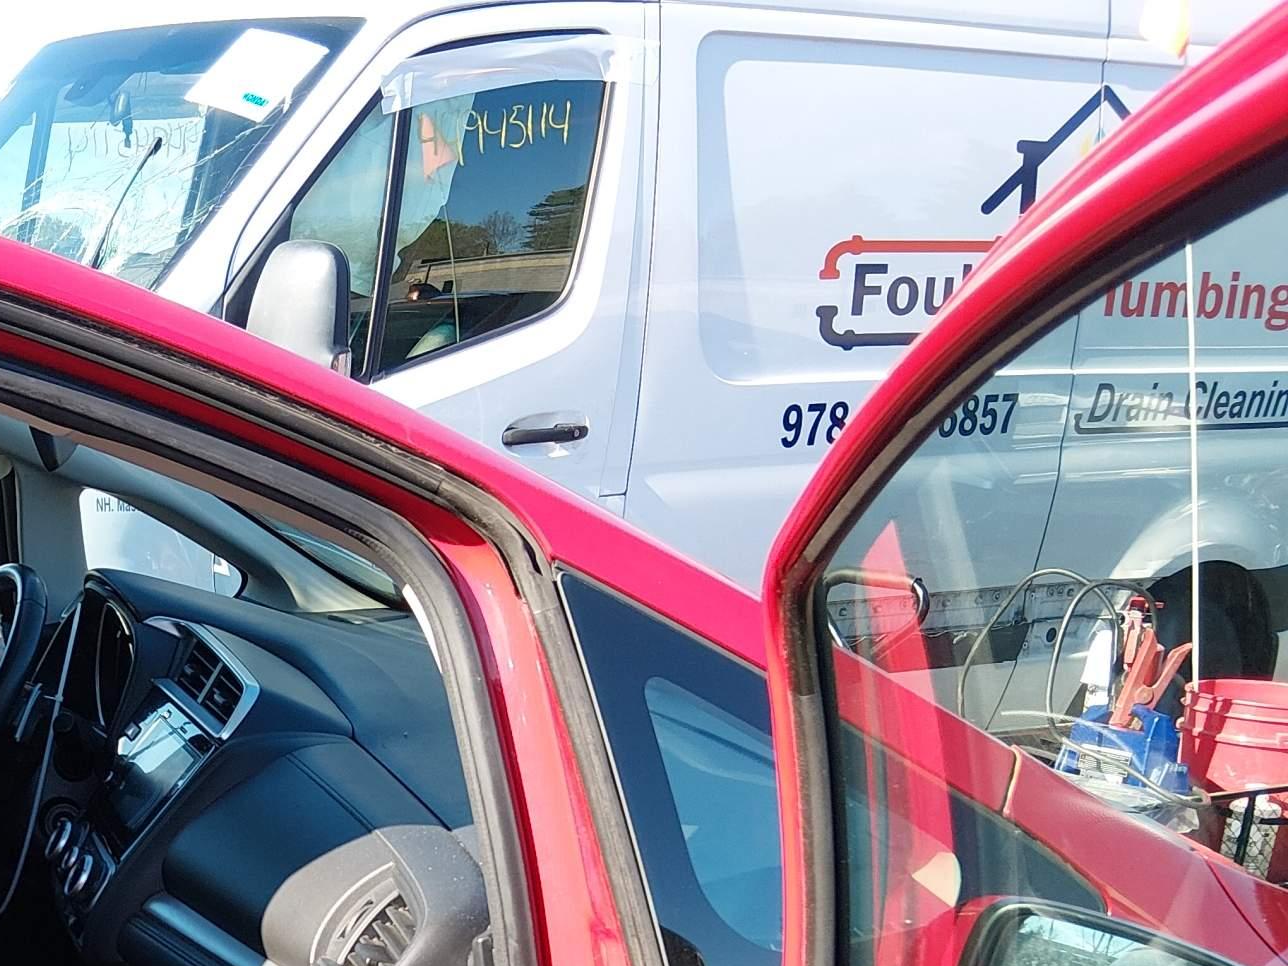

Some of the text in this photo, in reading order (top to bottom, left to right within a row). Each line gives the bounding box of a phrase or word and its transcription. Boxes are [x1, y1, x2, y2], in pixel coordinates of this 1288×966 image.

[1103, 271, 1288, 332] lumbing
[780, 400, 850, 448] 978
[1087, 382, 1174, 423] Drain
[96, 497, 114, 512] NH.
